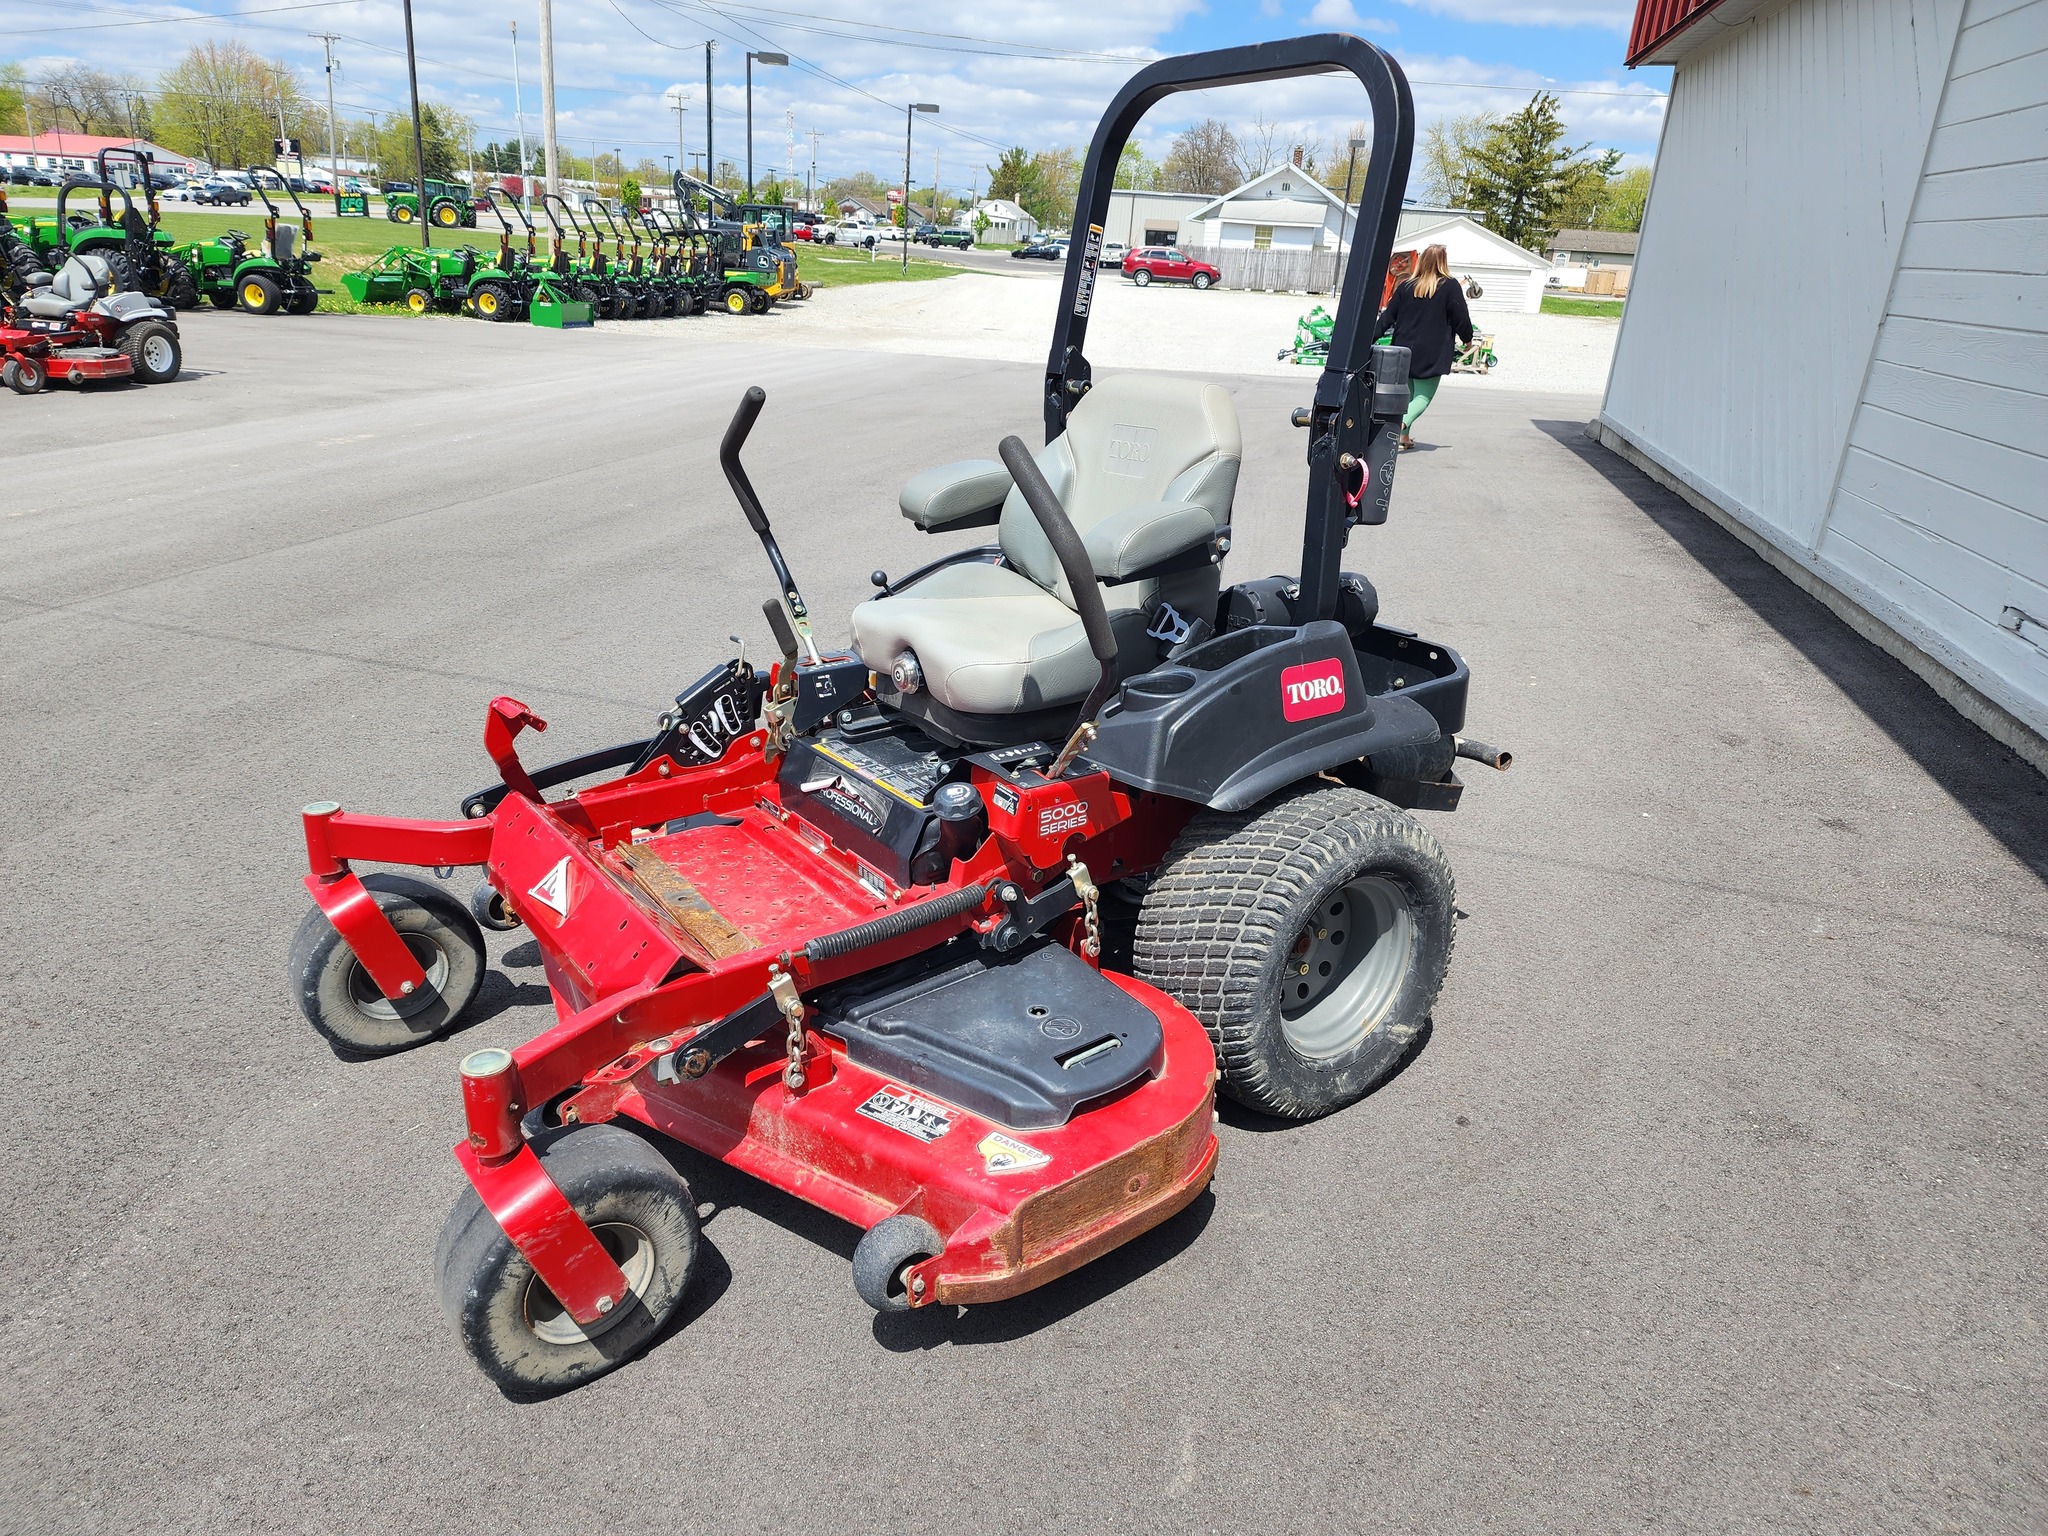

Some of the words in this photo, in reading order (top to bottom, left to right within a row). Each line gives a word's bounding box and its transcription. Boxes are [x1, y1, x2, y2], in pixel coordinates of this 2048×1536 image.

[1108, 439, 1151, 463] TORO
[1040, 801, 1089, 824] 5000
[1039, 814, 1087, 836] SERIES
[910, 1097, 948, 1117] DANGER
[993, 1135, 1044, 1160] DANGER
